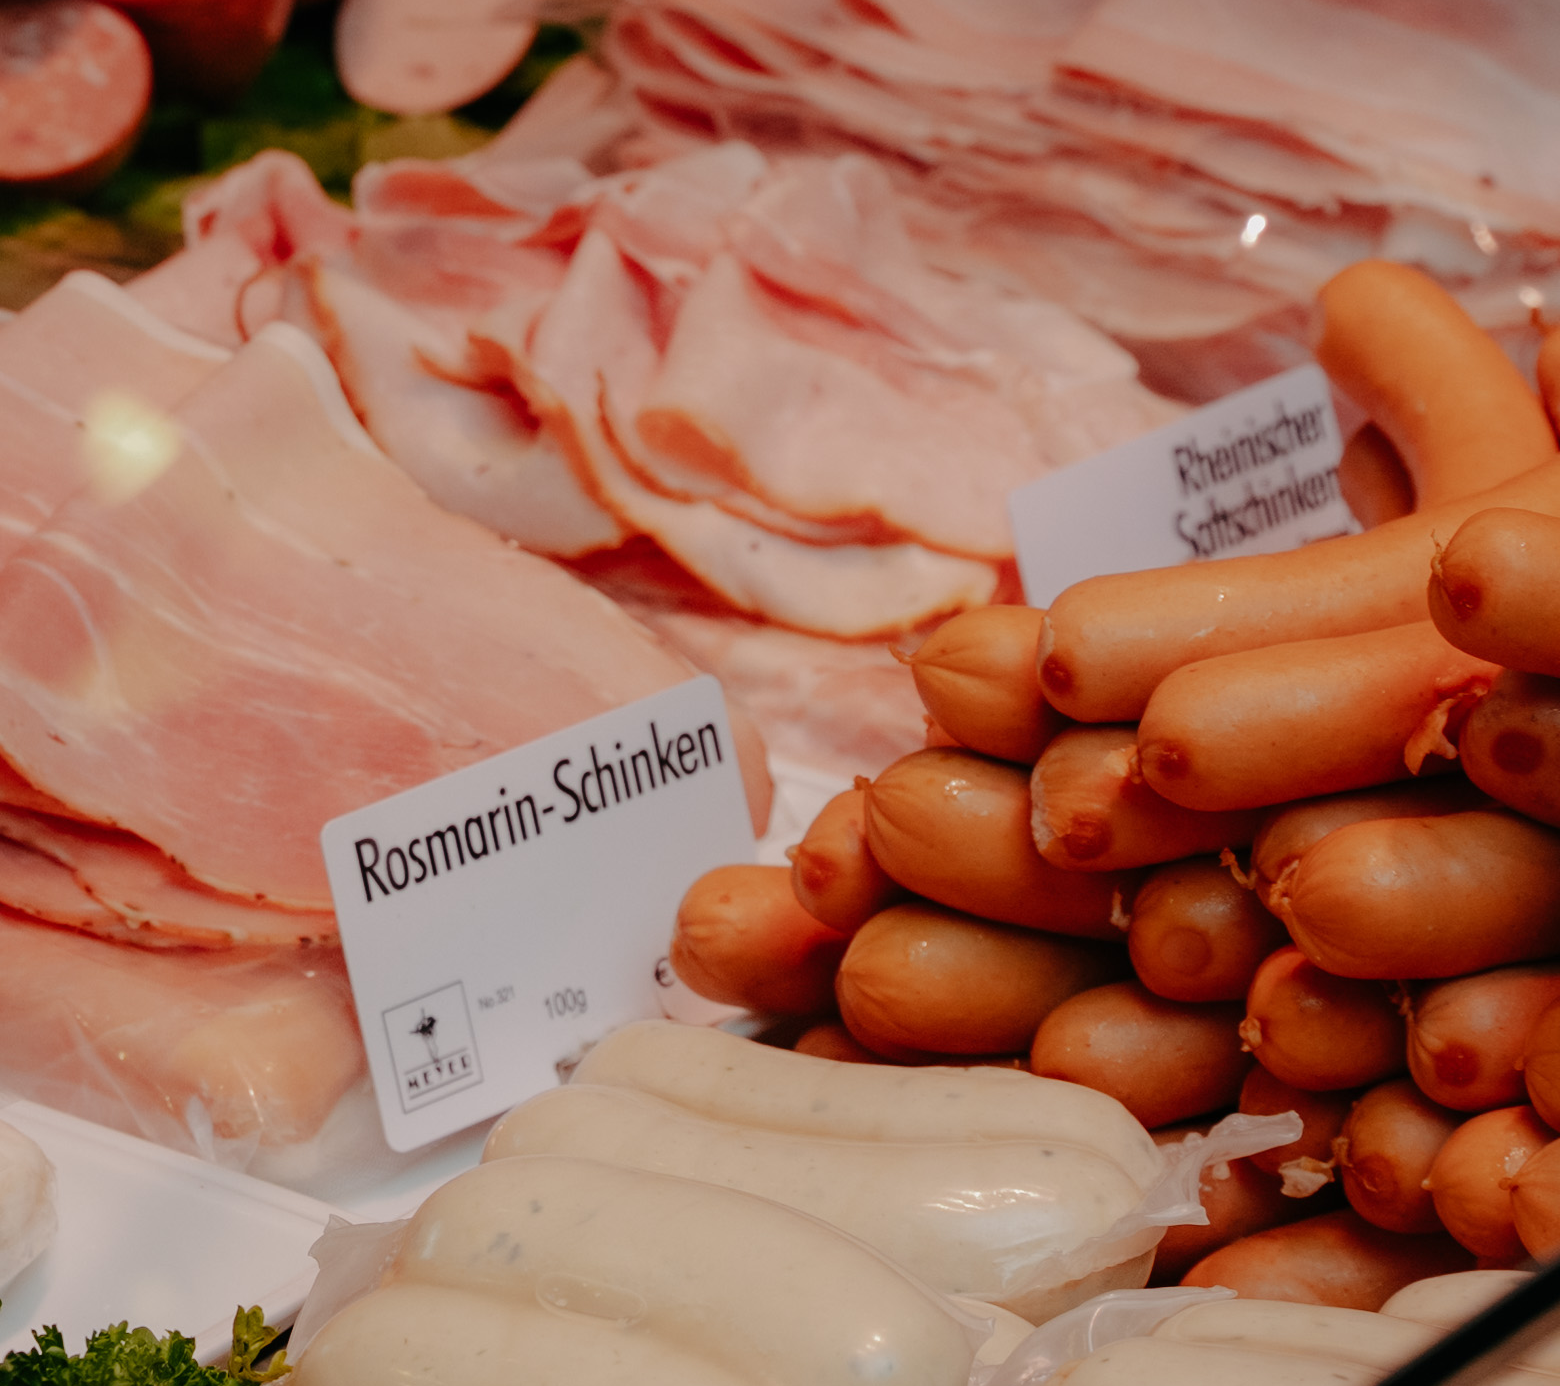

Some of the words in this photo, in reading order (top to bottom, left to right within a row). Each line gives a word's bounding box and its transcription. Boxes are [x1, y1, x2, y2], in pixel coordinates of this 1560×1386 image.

[1172, 398, 1326, 499] Rheinischer
[1172, 463, 1340, 558] Saftschinken
[354, 720, 724, 904] Rosmarin-Schinken
[544, 987, 589, 1020] 100g
[407, 1055, 471, 1092] MEYER
